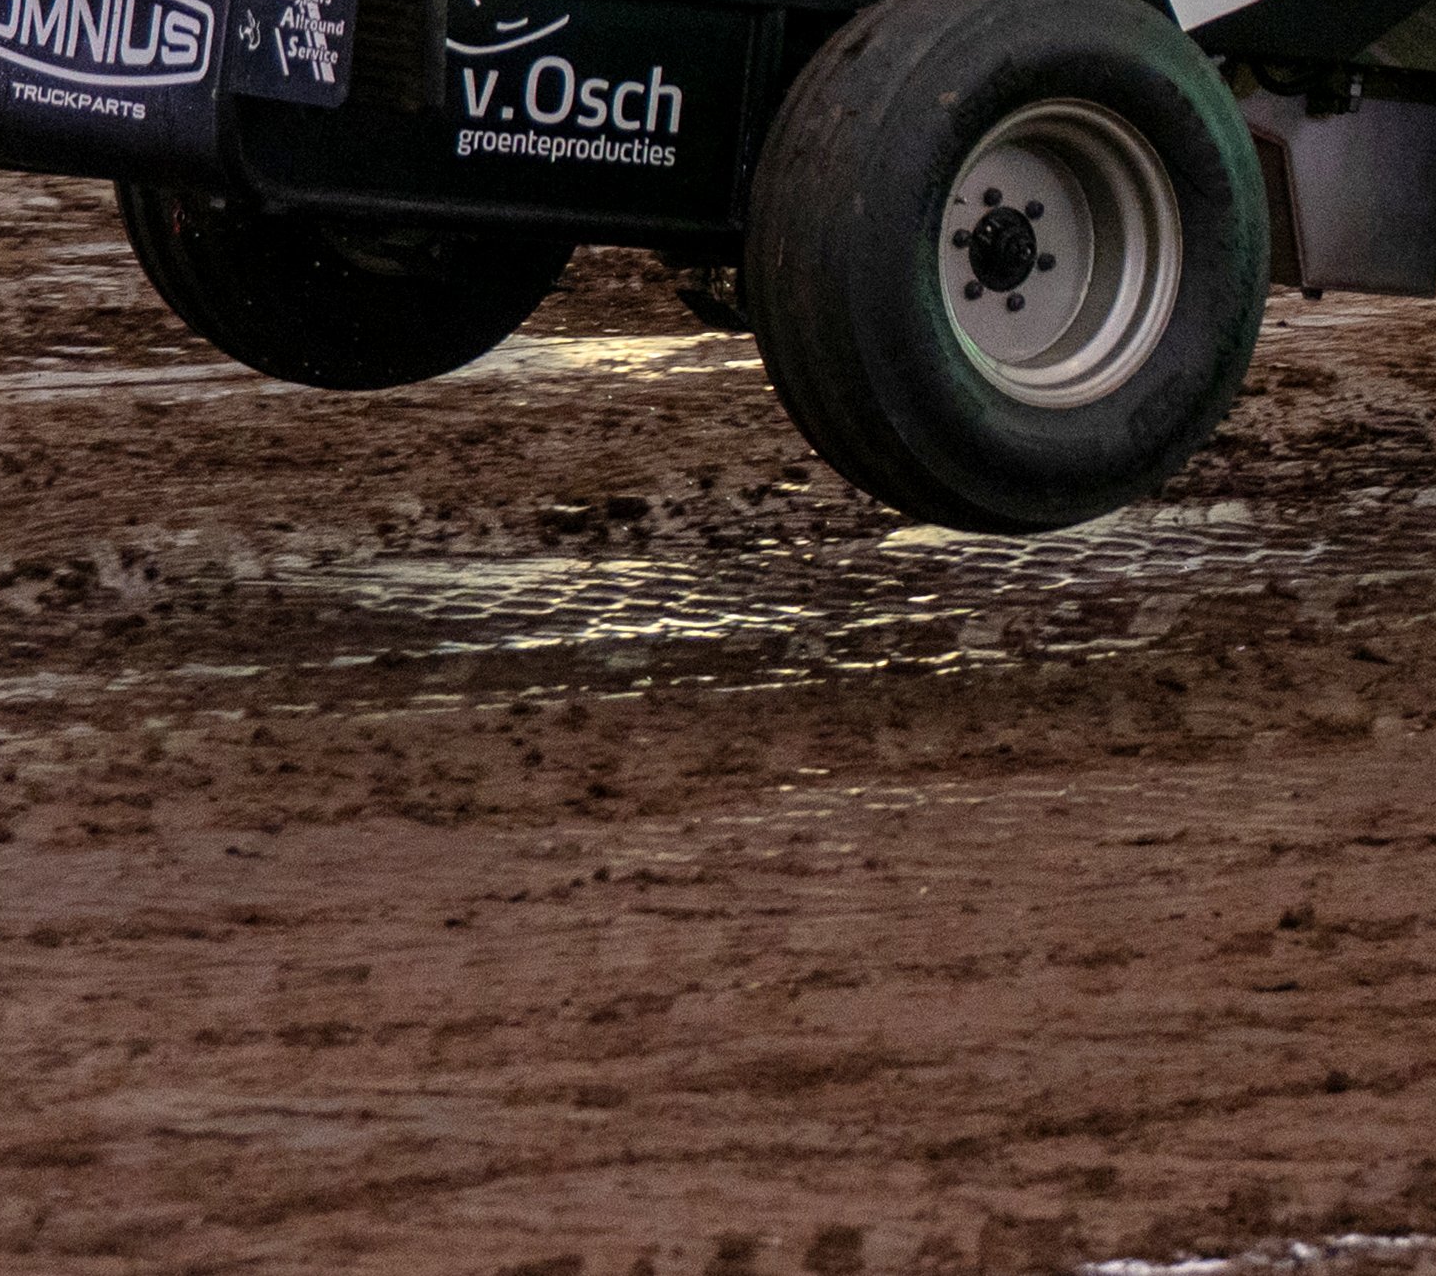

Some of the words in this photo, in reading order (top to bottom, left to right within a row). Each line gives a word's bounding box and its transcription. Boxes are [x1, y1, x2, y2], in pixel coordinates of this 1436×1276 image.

[279, 6, 346, 36] Allround
[287, 35, 339, 65] Service
[11, 81, 147, 120] TRUCKPARTS
[456, 128, 677, 167] groenteproducties
